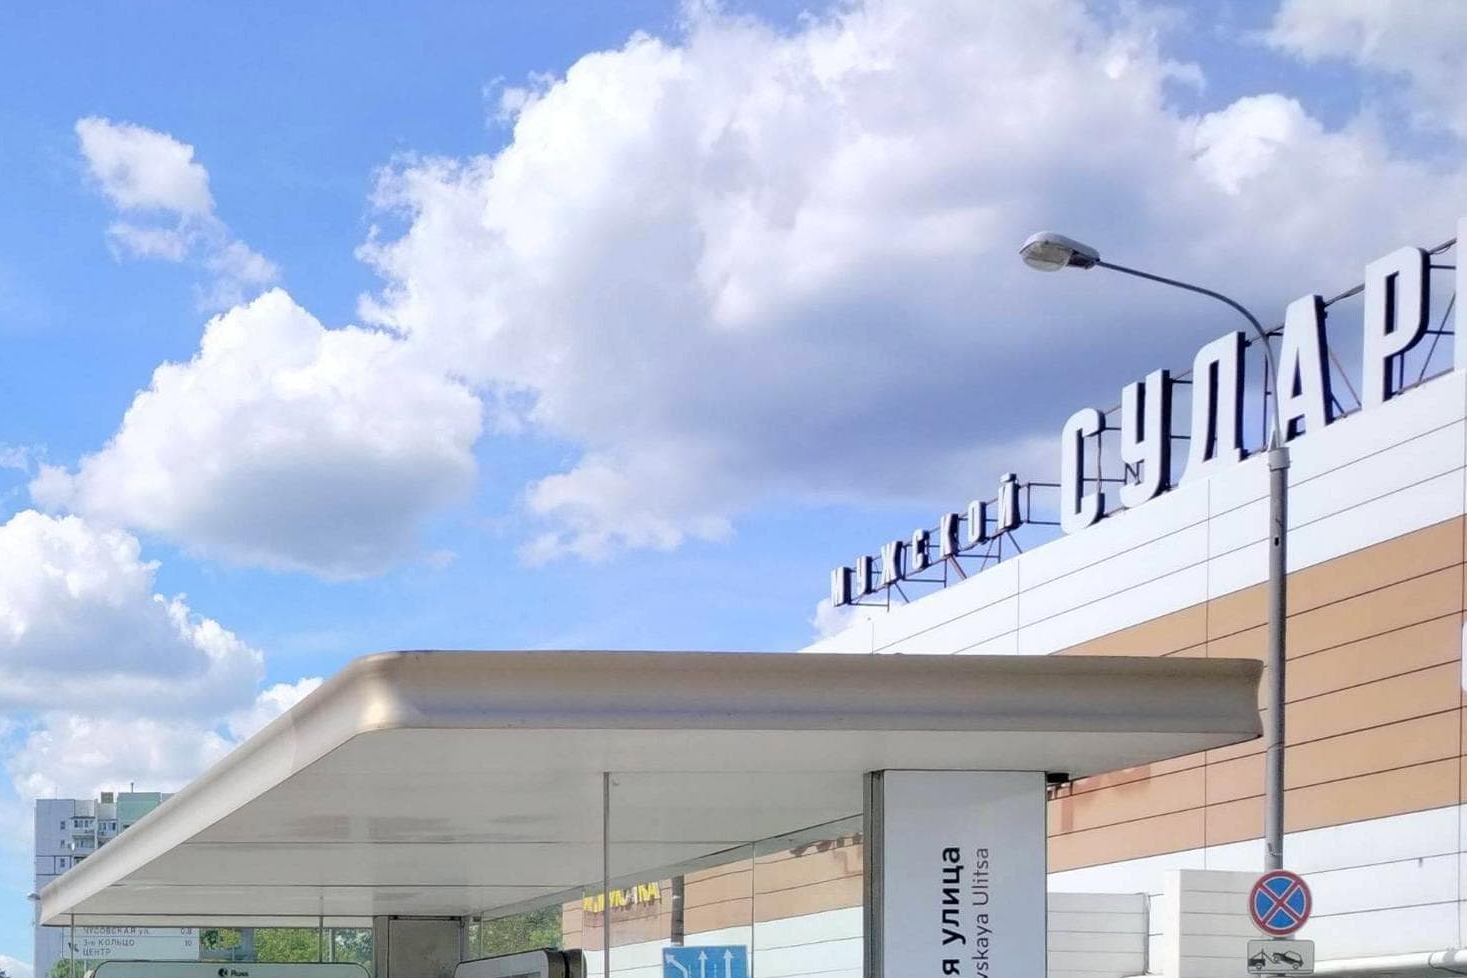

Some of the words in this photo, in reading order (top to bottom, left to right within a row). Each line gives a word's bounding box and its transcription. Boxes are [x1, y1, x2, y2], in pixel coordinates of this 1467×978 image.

[831, 473, 1020, 607] МУЖСКОЙ
[942, 847, 966, 945] улица
[971, 847, 990, 904] Ulitsa
[82, 948, 112, 957] ЦЕНТР
[98, 938, 135, 948] КОЛЬЦО
